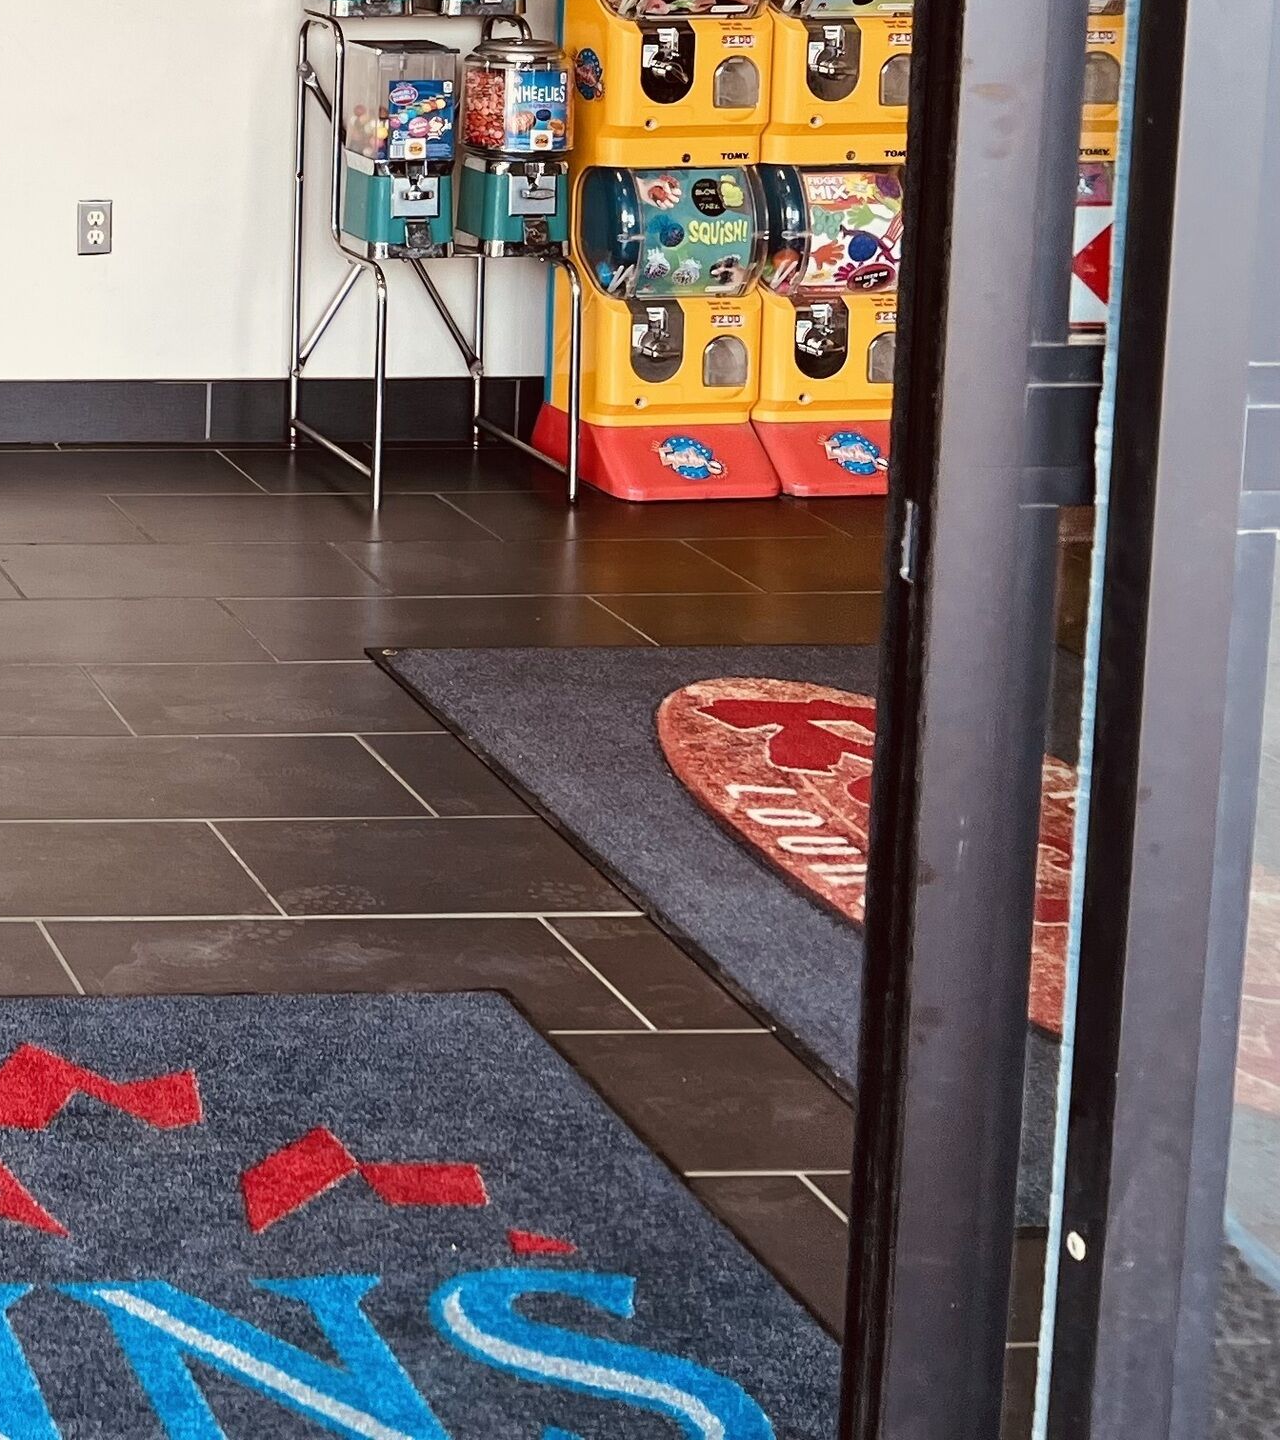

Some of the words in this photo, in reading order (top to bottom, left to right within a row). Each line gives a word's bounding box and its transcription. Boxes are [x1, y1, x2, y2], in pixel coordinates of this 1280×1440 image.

[721, 152, 748, 160] TOMY
[884, 150, 906, 158] TOM
[810, 185, 849, 200] MIX
